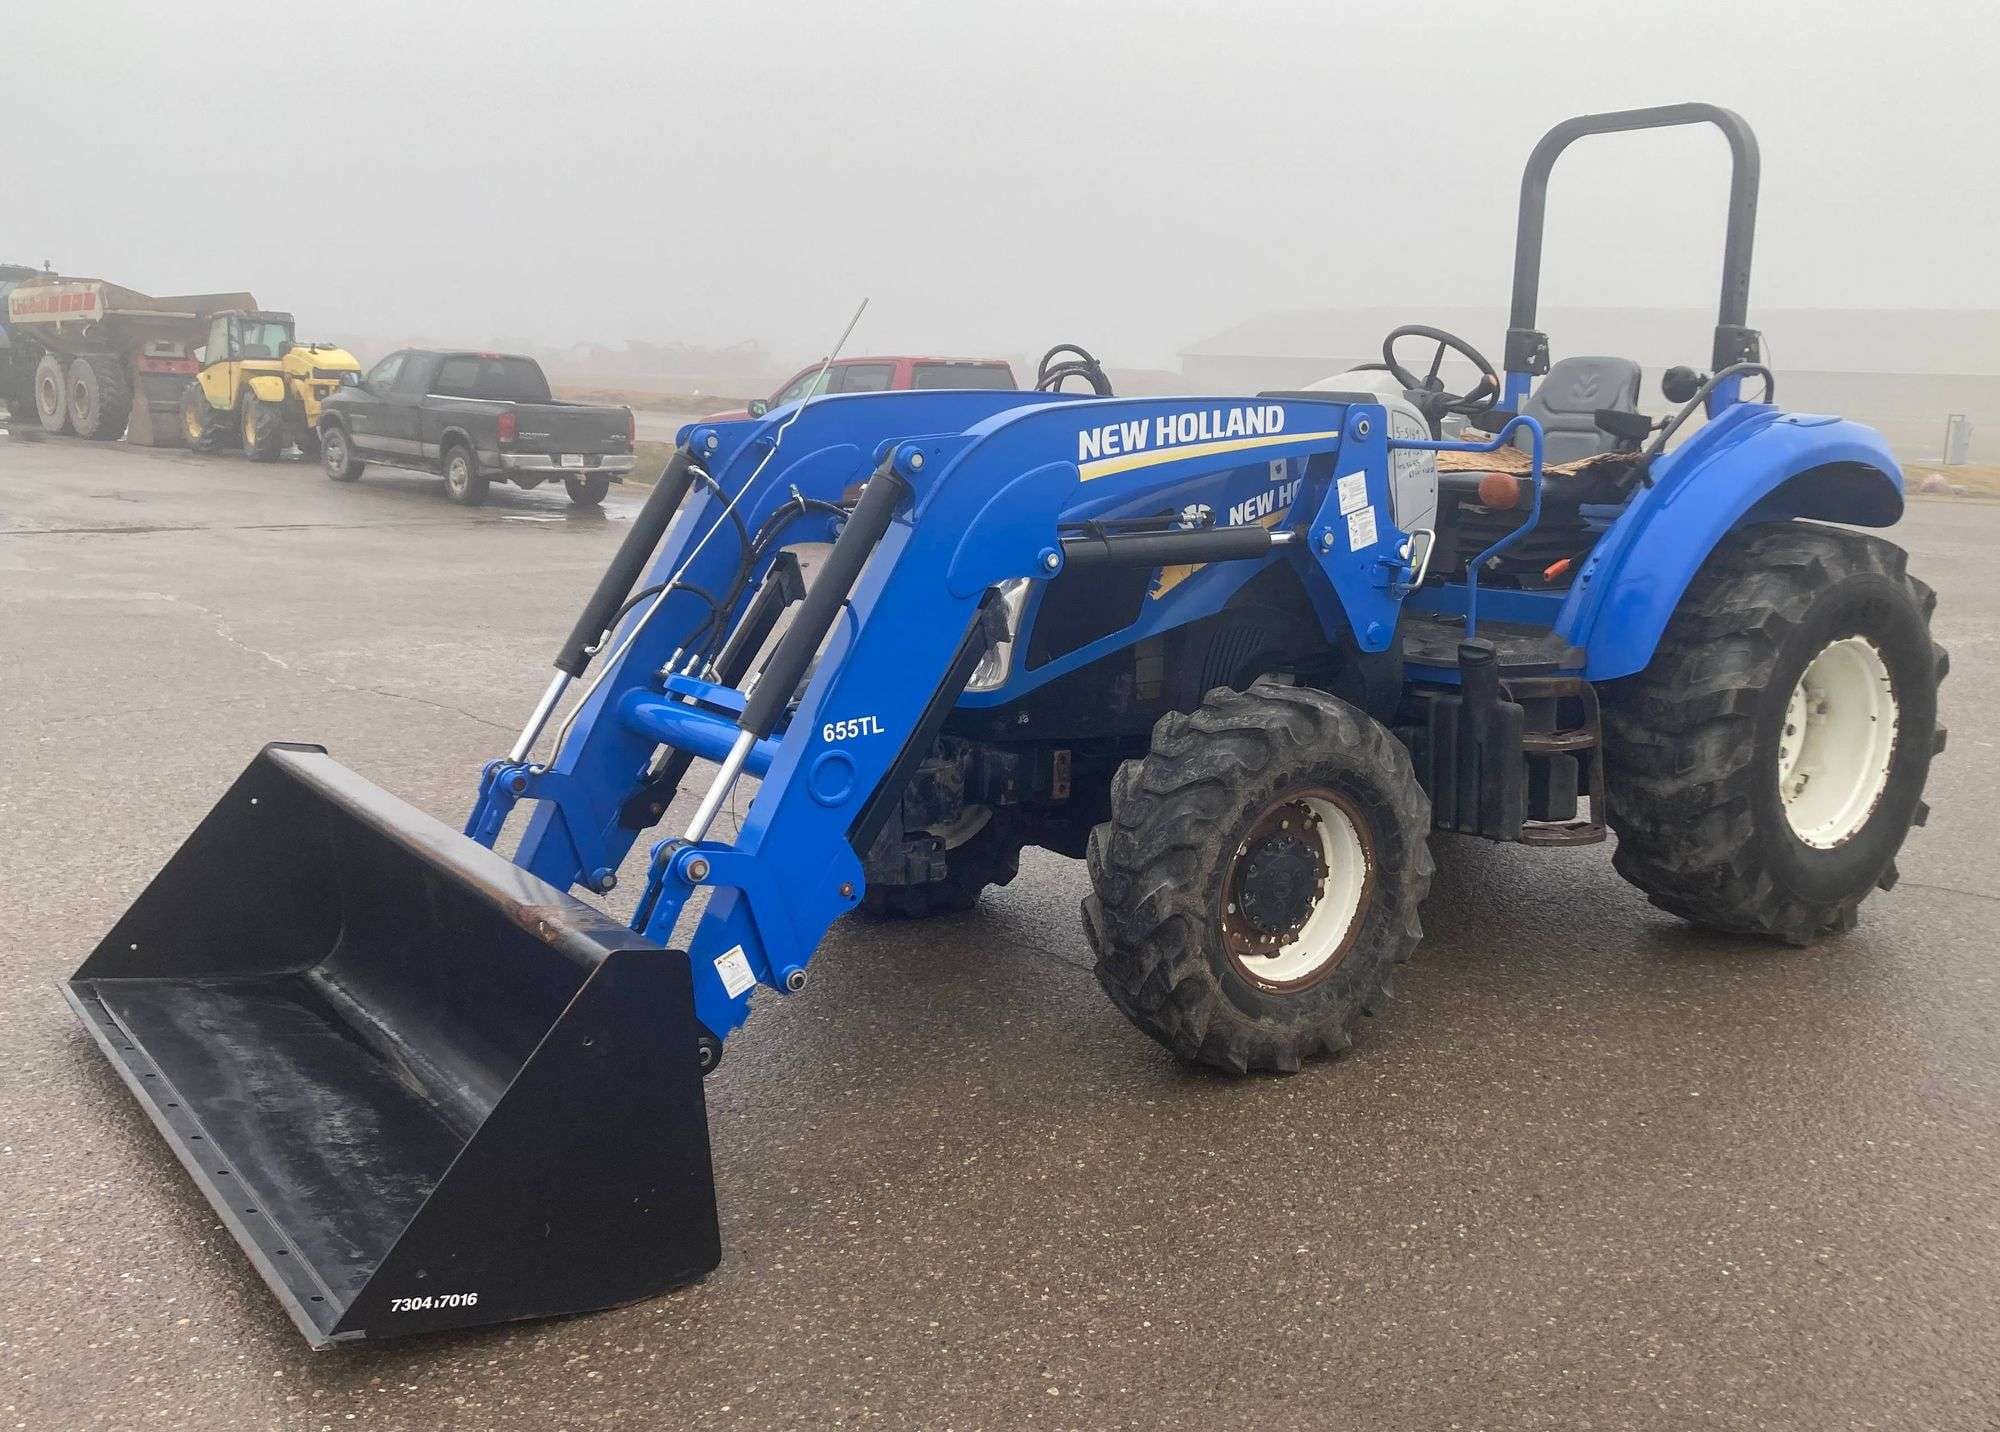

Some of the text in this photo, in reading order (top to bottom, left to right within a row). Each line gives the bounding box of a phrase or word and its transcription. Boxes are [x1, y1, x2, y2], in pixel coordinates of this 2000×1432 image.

[1079, 405, 1285, 460] NEW HOLLAND
[1229, 490, 1275, 526] NEW
[823, 715, 885, 743] 655TL
